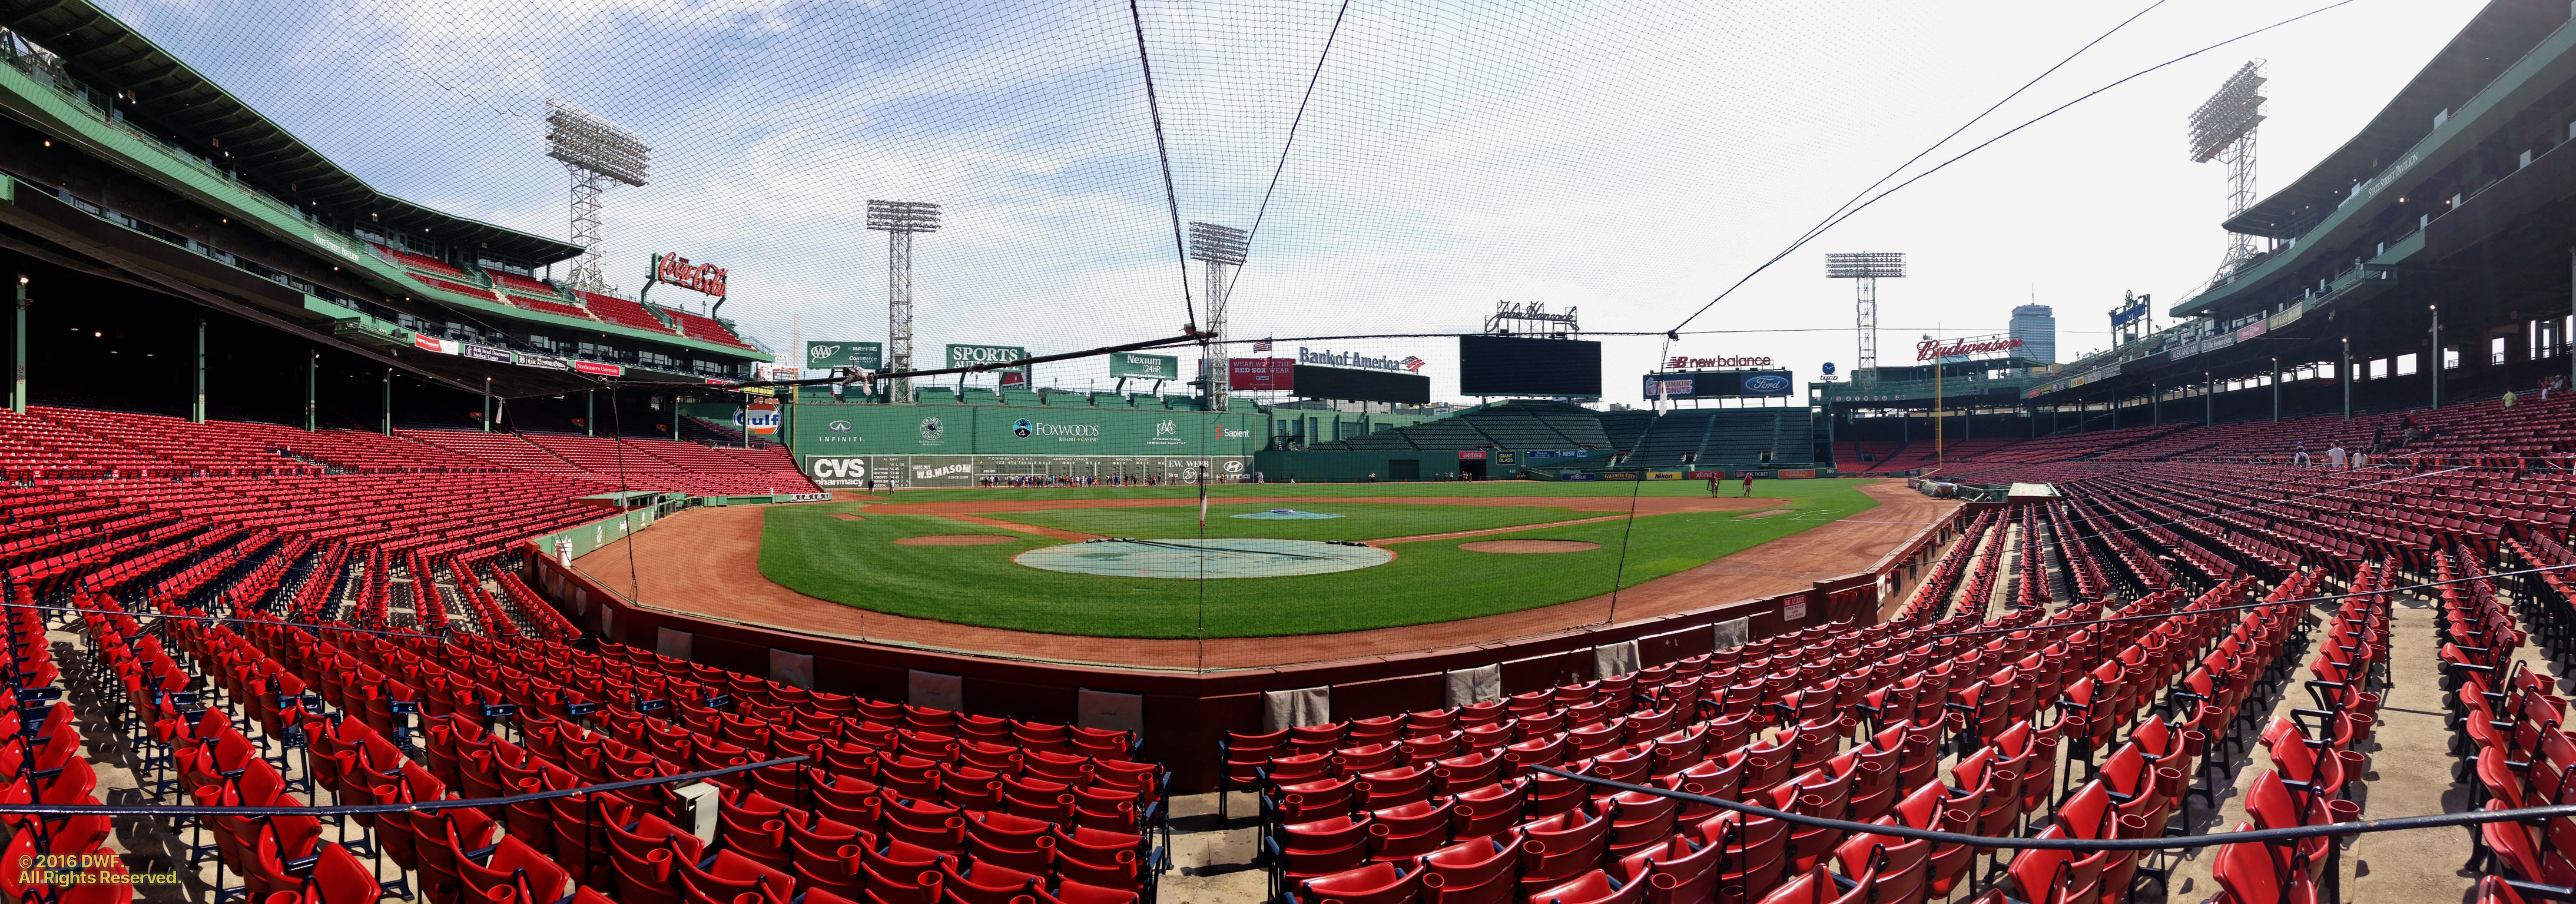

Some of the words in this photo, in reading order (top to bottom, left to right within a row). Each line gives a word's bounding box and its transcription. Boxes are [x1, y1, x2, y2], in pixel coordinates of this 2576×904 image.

[2368, 182, 2380, 198] STATE
[2380, 170, 2396, 189] STREET
[2396, 152, 2418, 177] PAVILION
[314, 234, 326, 247] STATE
[326, 240, 341, 254] STREET
[342, 247, 359, 262] PAVILION
[658, 252, 729, 297] Coca-Cola
[1486, 300, 1523, 333] John
[1523, 301, 1580, 331] Hancock
[813, 346, 830, 358] AAA
[953, 346, 1018, 361] SPORTS
[1917, 335, 2023, 361] Budweiser
[2173, 350, 2182, 359] ALEX
[2182, 347, 2190, 357] AND
[1127, 354, 1161, 365] Nexium
[1299, 347, 1334, 365] Bank
[1335, 351, 1348, 366] of
[1352, 352, 1400, 371] America
[1690, 358, 1715, 368] new
[1718, 355, 1771, 367] balance
[577, 363, 600, 371] Northeastern
[601, 366, 618, 374] University
[1754, 378, 1780, 389] Ford
[737, 413, 779, 426] Gulf
[1036, 423, 1099, 436] FOXWOODS
[1224, 428, 1249, 438] Sapient
[814, 458, 865, 478] CVS
[815, 478, 864, 487] pharmacy
